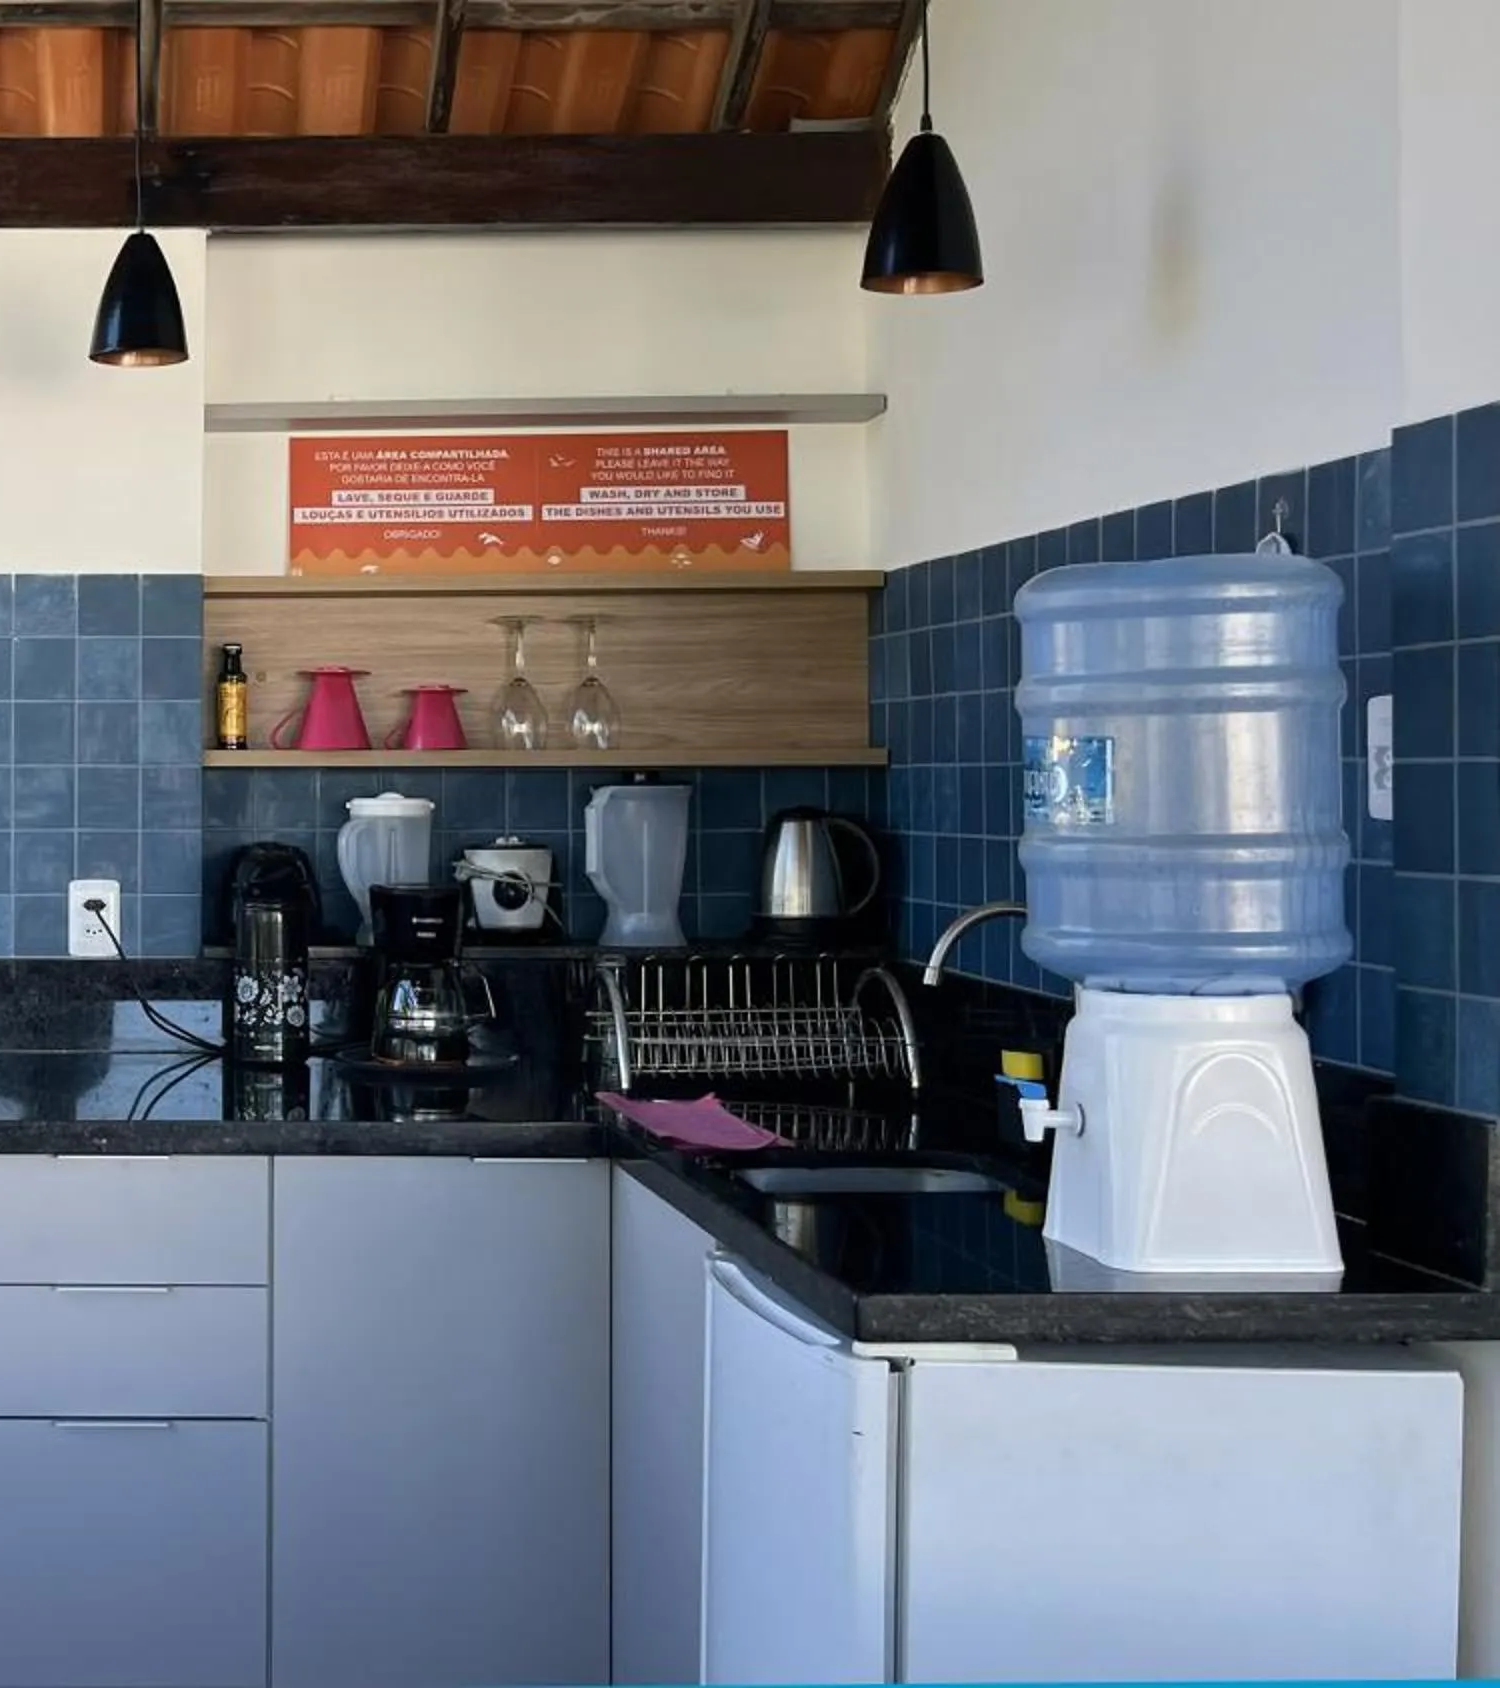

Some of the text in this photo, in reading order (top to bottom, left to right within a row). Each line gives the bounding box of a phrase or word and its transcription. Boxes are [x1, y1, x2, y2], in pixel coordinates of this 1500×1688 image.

[315, 451, 340, 461] ESTA
[351, 451, 374, 460] UMA
[376, 449, 407, 460] ÁREA
[408, 449, 510, 459] COMPARTILHADA
[596, 445, 726, 457] THIS IS A SHARED AREA
[329, 462, 352, 473] POR
[354, 462, 388, 472] FAVOR
[432, 461, 465, 472] COMO
[596, 457, 730, 469] PLEASE LEAVE IT THE WAY
[341, 473, 393, 485] GOSTARIA
[395, 474, 410, 484] DE
[591, 468, 735, 480] YOU WOULD LIKE TO FIND IT
[378, 492, 421, 503] SEQUE
[423, 492, 431, 501] E
[435, 491, 489, 501] GUARDE
[589, 486, 738, 500] WASH, DRY AND STORE
[301, 509, 353, 521] LOUÇAS
[357, 509, 364, 518] E
[449, 507, 526, 518] UTILIZADOS
[546, 503, 782, 516] THE DISHES AND UTENSILS YOU USE
